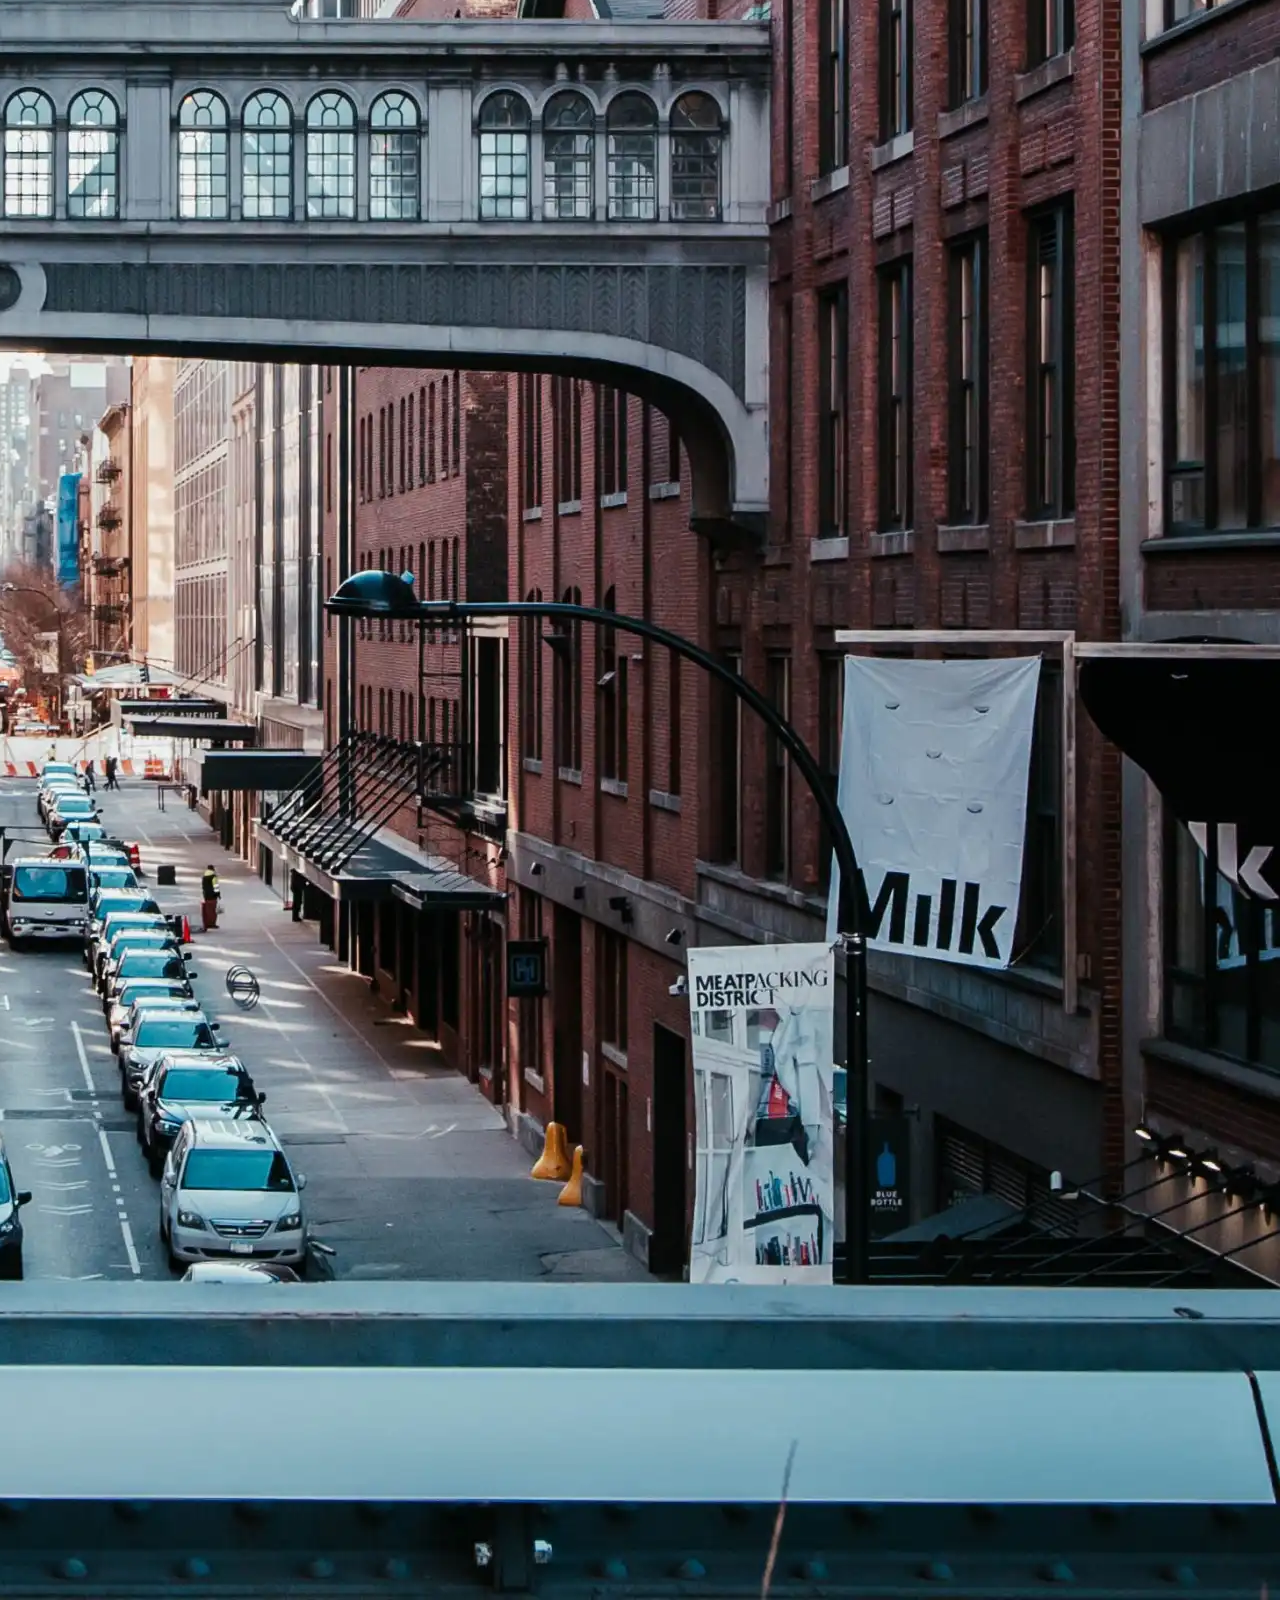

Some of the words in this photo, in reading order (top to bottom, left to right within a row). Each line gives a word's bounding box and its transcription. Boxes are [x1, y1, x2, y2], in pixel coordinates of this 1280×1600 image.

[838, 869, 1007, 959] Milk
[696, 970, 829, 991] MEATPACKING
[697, 988, 779, 1007] DISTRICT
